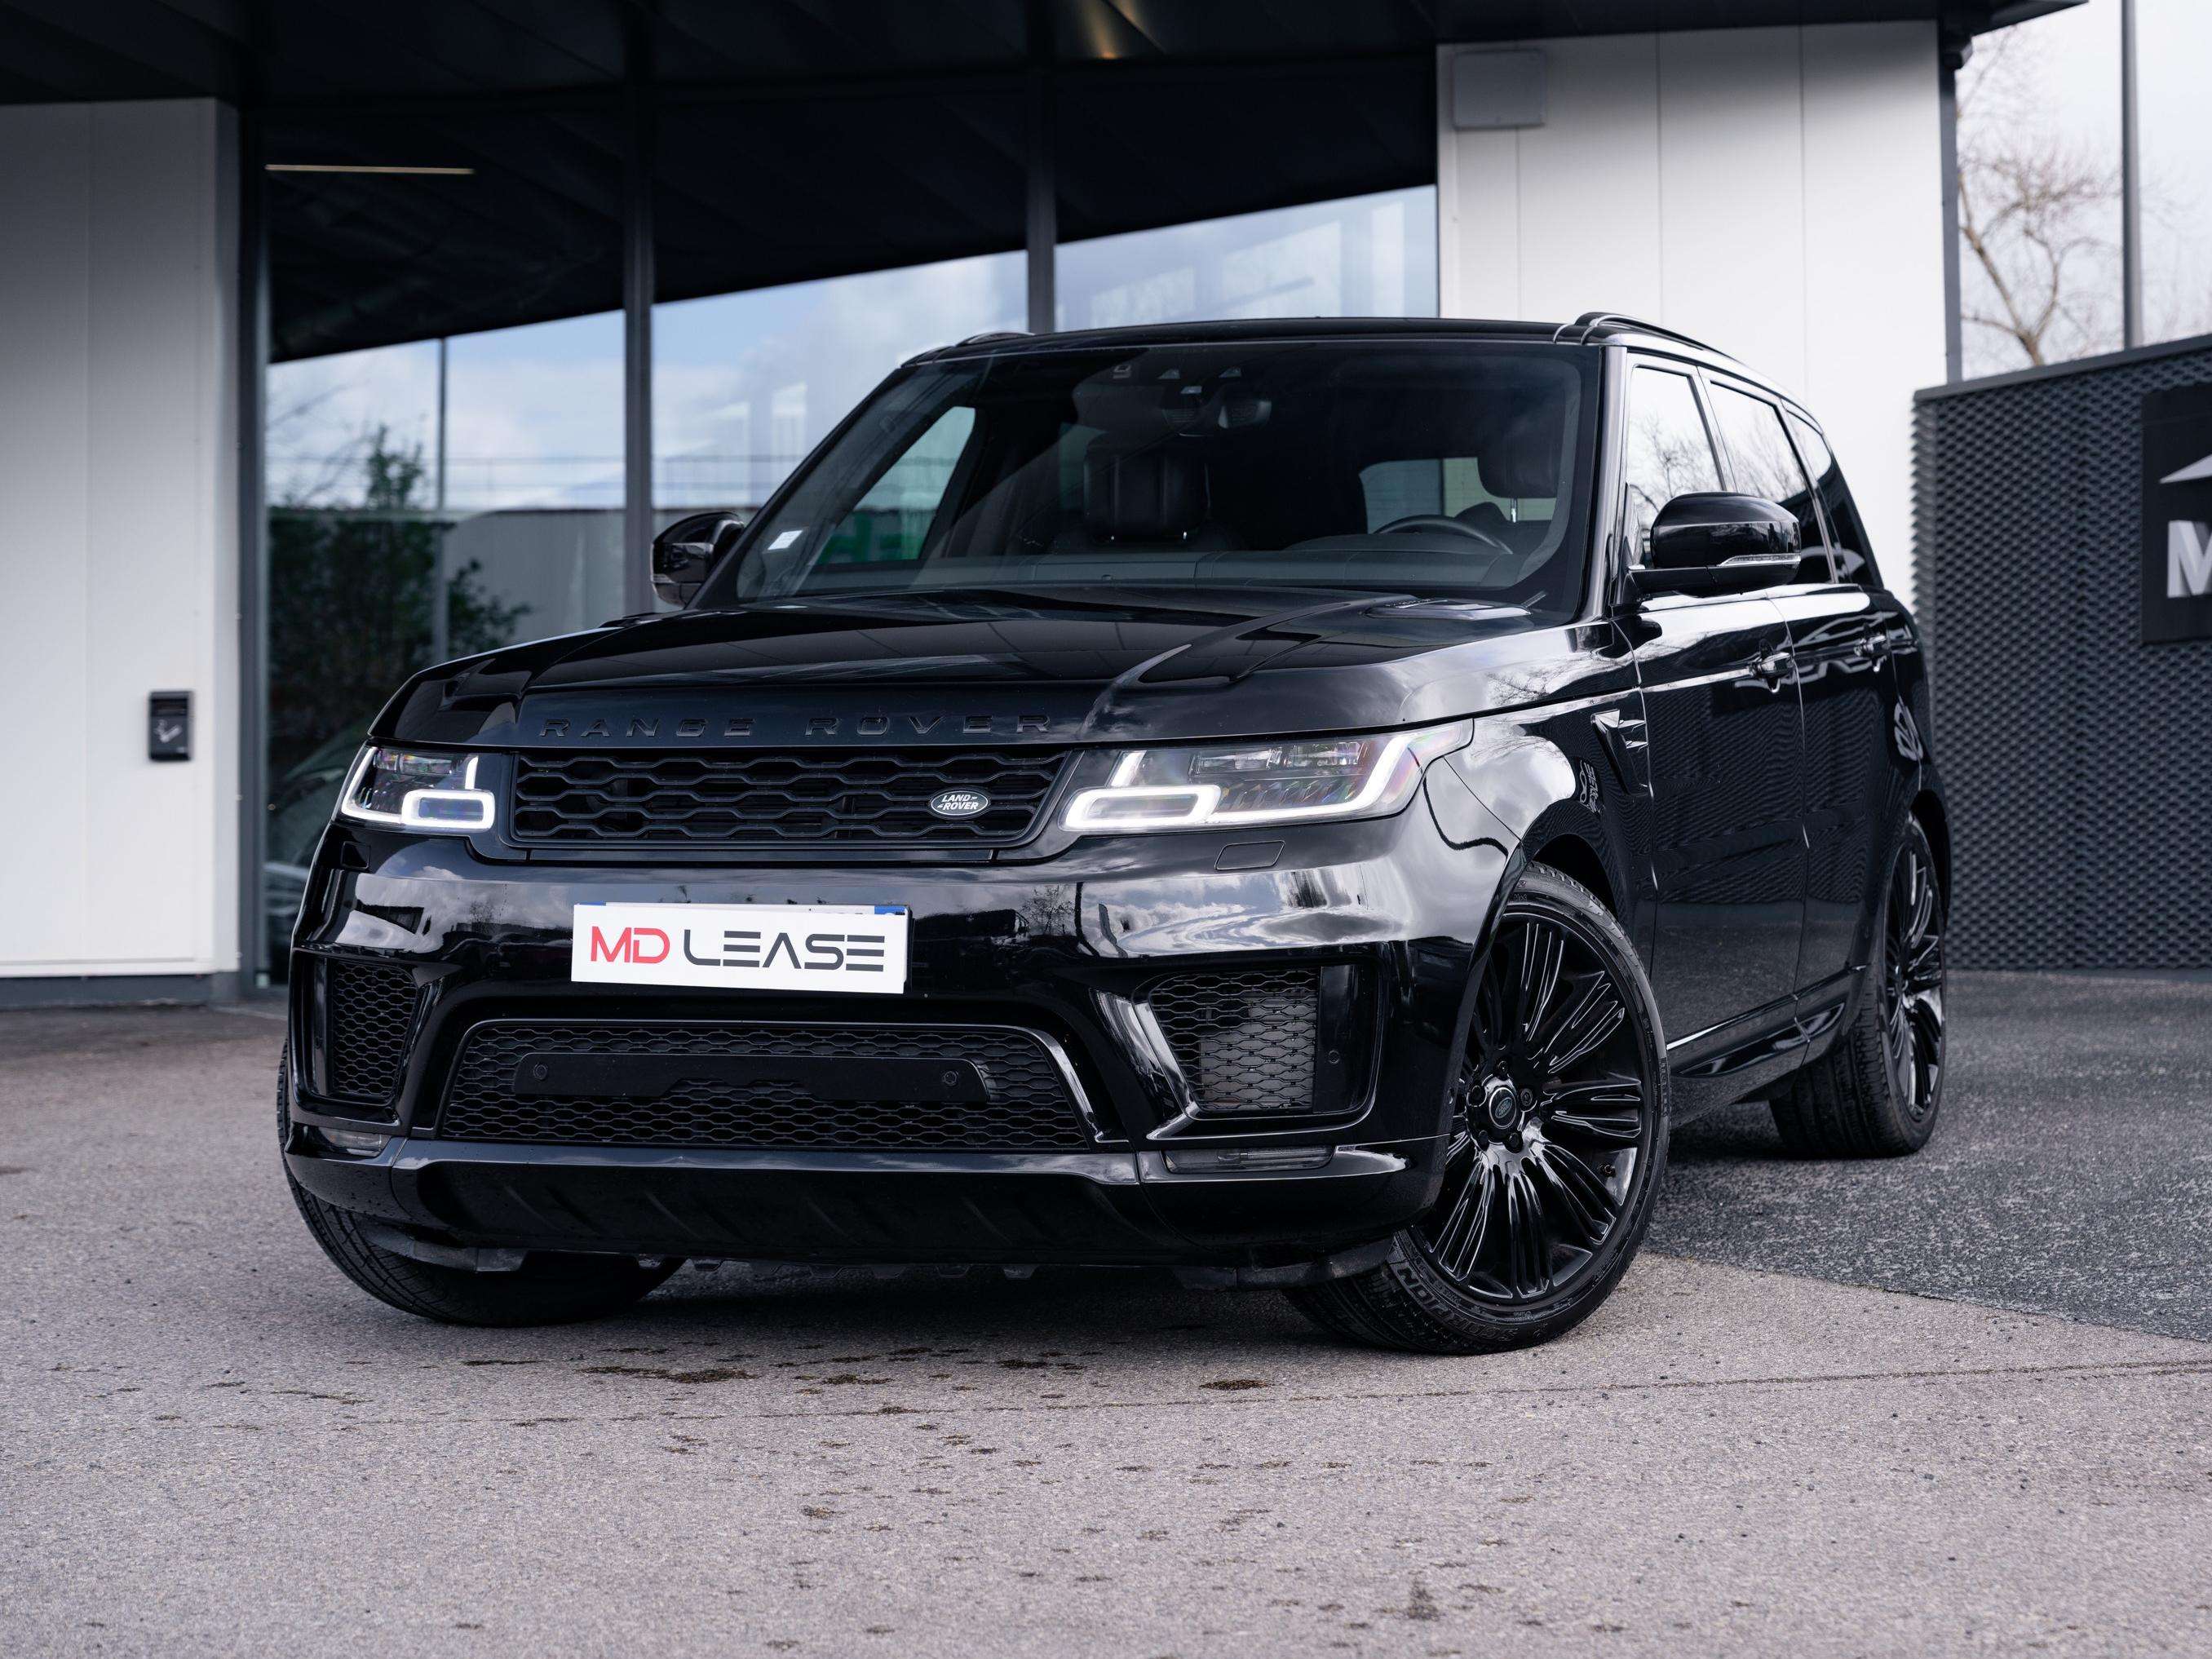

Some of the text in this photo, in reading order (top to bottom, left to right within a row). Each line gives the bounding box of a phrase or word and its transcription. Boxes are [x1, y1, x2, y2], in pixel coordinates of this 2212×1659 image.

[541, 714, 1051, 737] RANGE ROVER
[941, 794, 971, 803] LAND
[942, 802, 979, 811] ROVER
[591, 926, 886, 972] MD LEASE
